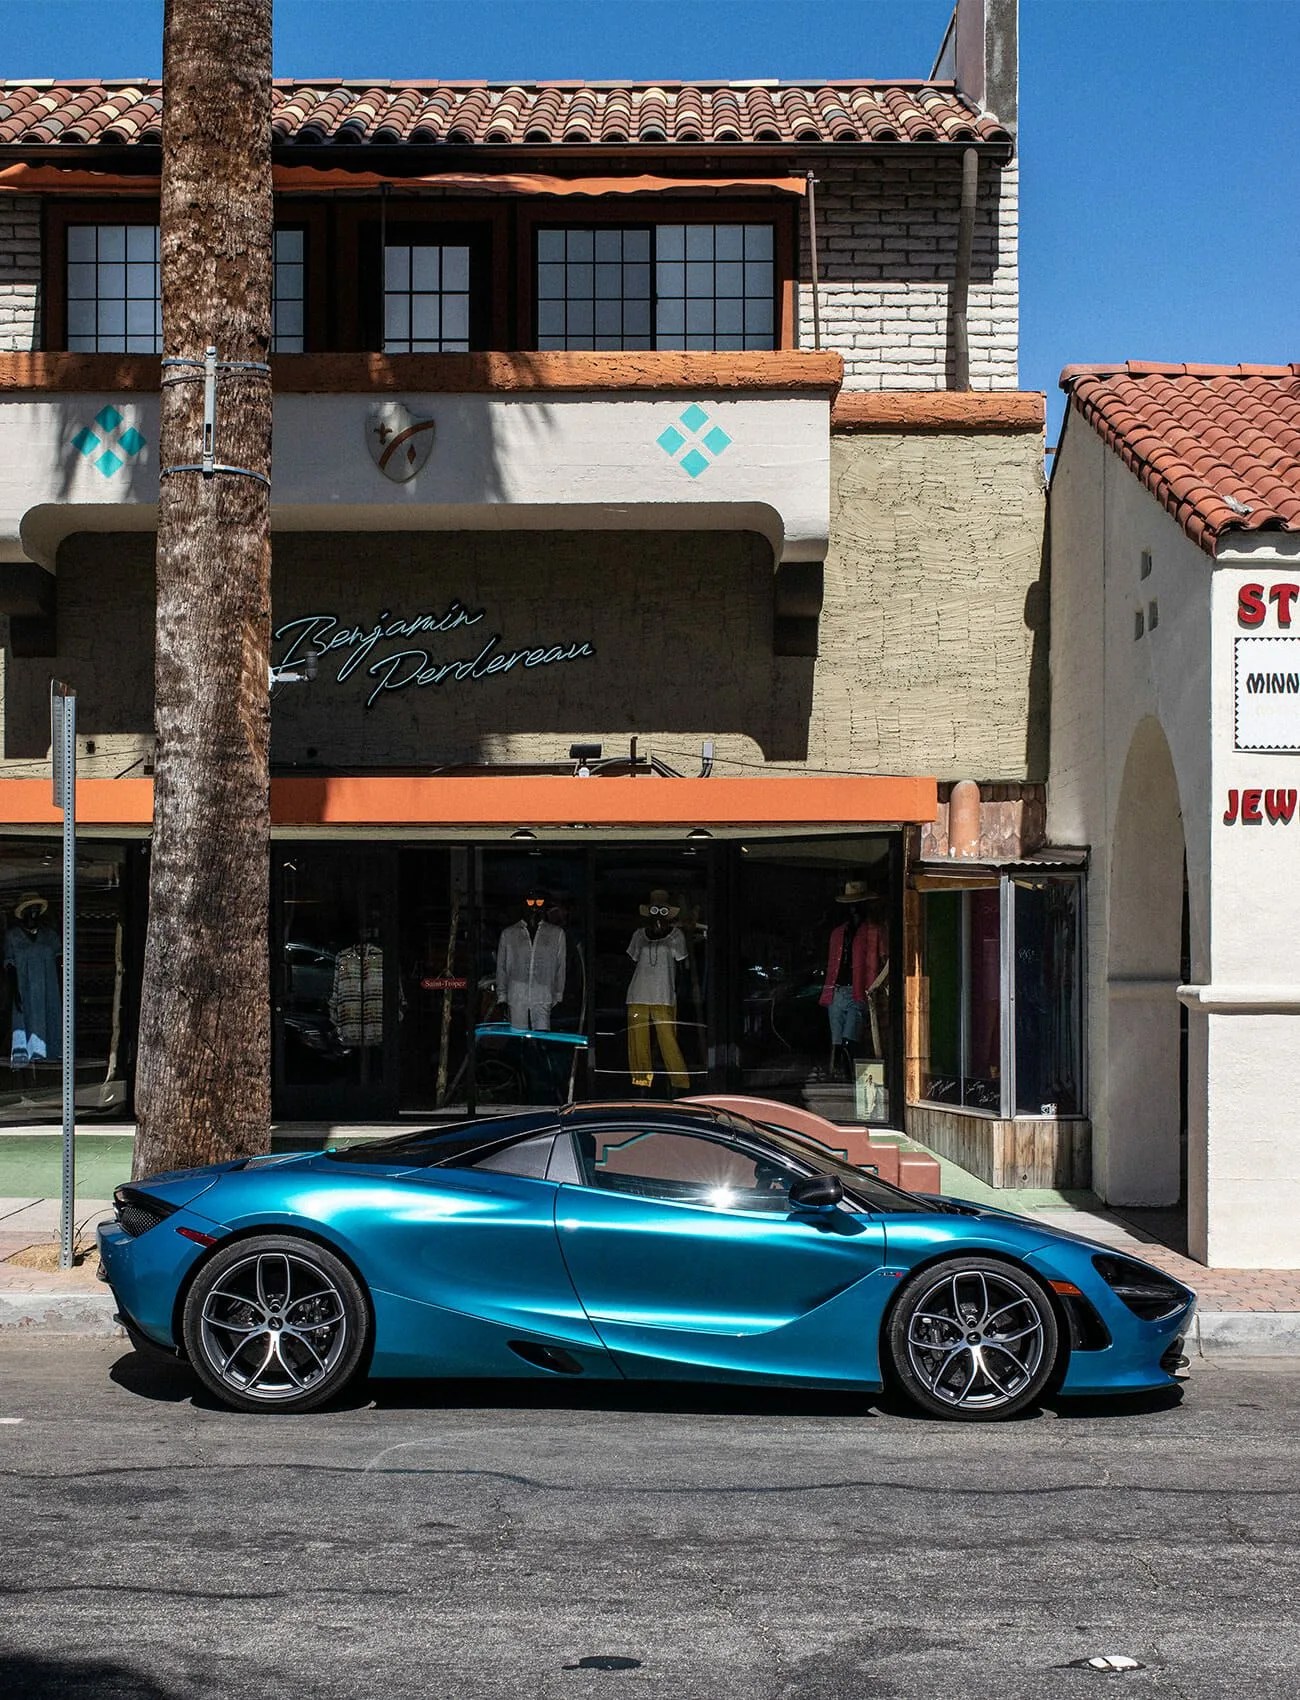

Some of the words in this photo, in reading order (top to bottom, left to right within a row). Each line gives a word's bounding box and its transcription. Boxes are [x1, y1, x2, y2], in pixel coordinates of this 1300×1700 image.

[1238, 583, 1299, 629] ST
[271, 603, 483, 682] Benjamin
[366, 637, 594, 706] Perdereau
[1246, 672, 1299, 694] MINN
